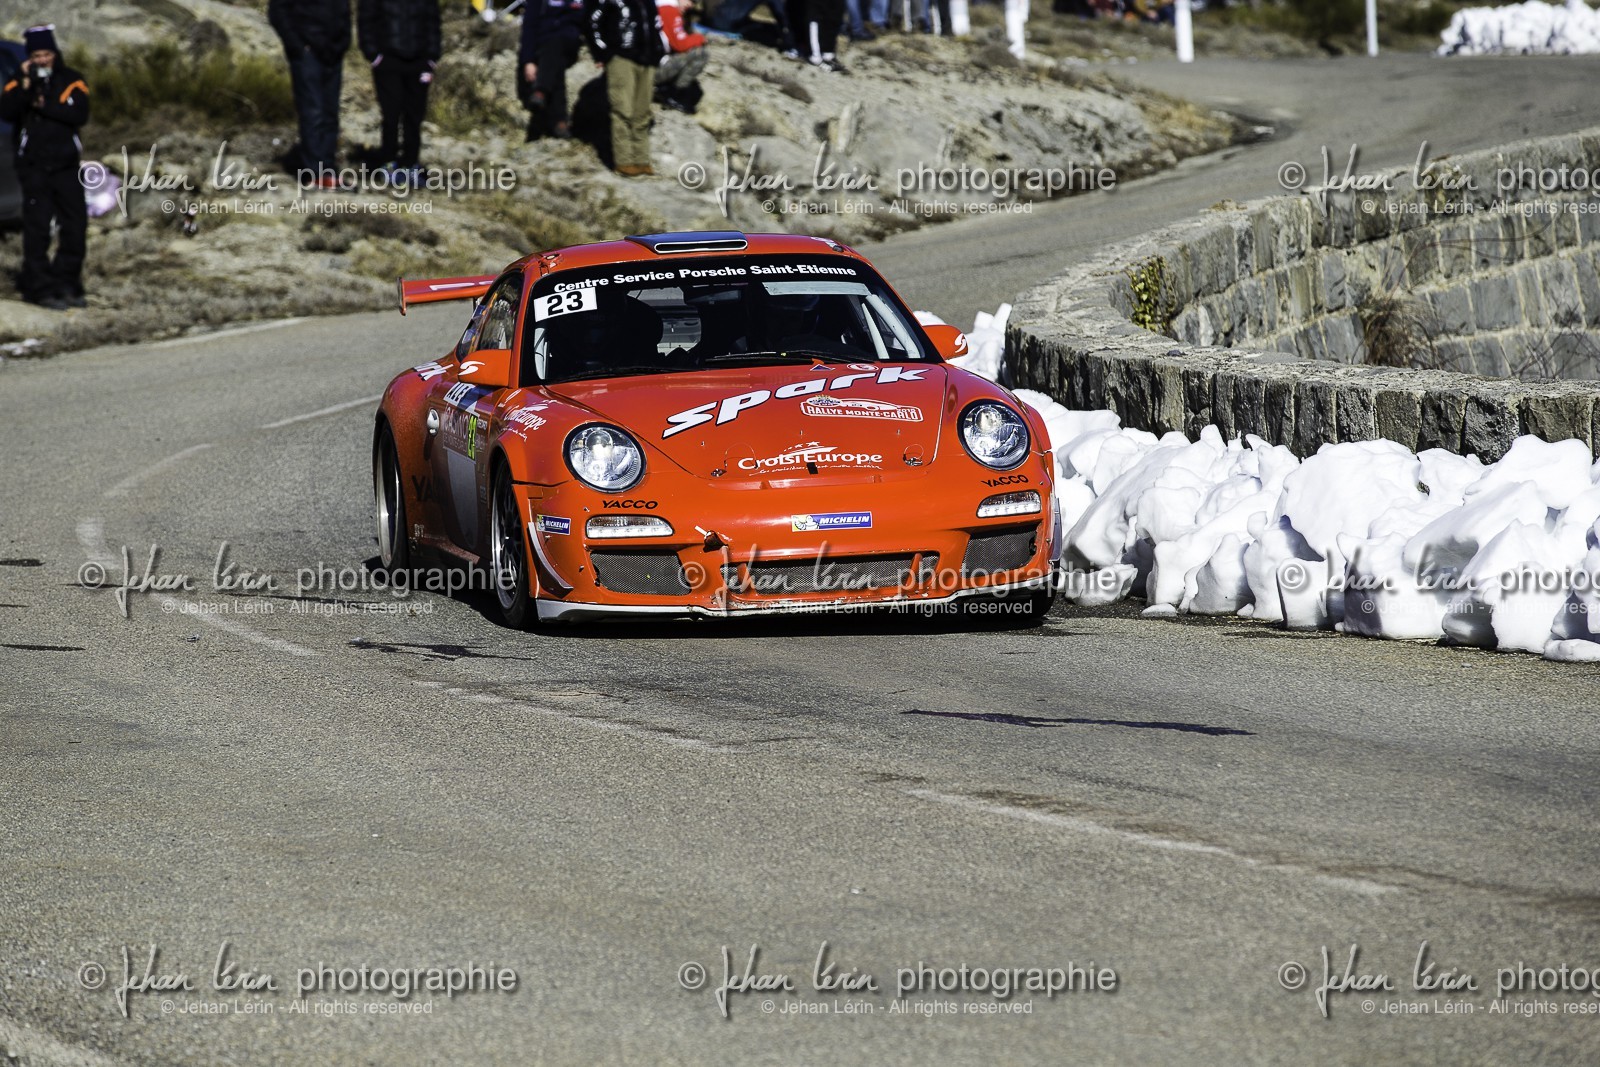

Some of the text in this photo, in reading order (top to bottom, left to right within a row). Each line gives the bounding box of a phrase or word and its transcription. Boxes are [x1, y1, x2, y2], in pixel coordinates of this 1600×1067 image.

[554, 264, 857, 293] Centre Service Porsche Saint-Etienne
[547, 291, 584, 316] 23
[806, 405, 842, 415] RALLYE
[981, 474, 1029, 487] YACCO
[602, 499, 658, 510] YACCO
[545, 520, 569, 529] MICHELIN
[819, 515, 870, 525] MICHELIN
